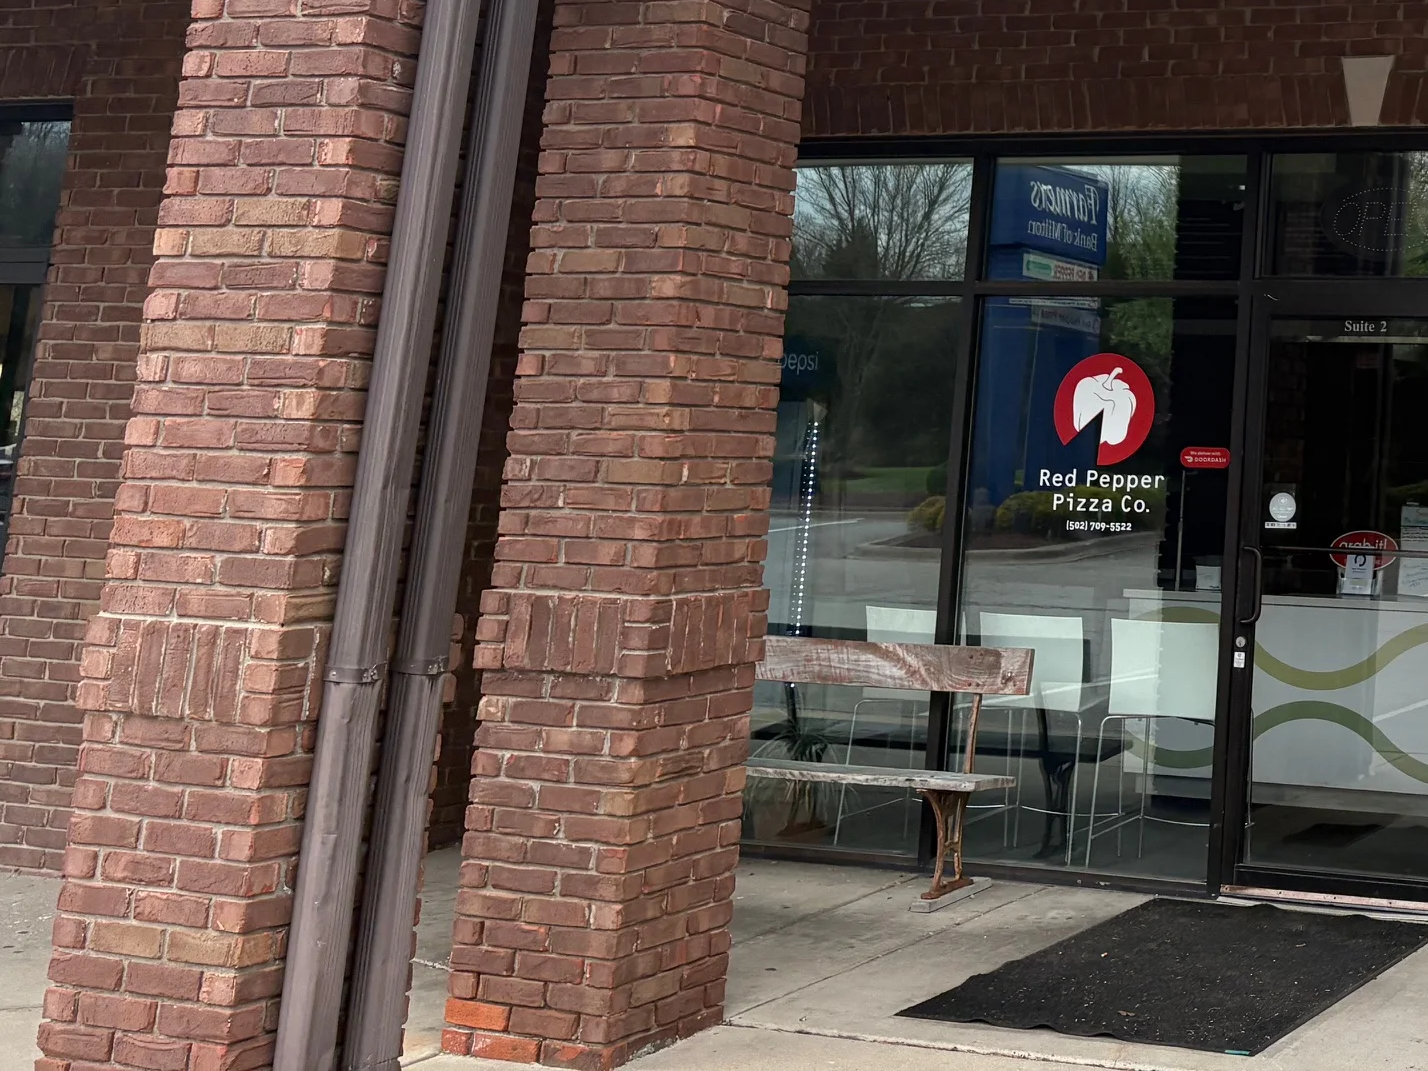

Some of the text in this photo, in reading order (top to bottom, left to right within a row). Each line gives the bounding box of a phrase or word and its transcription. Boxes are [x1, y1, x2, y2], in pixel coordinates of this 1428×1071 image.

[1344, 320, 1387, 332] Suite 2
[1039, 469, 1165, 492] Red Pepper
[1052, 493, 1150, 513] Pizza Co.
[1066, 520, 1132, 532] (502) 709-5522
